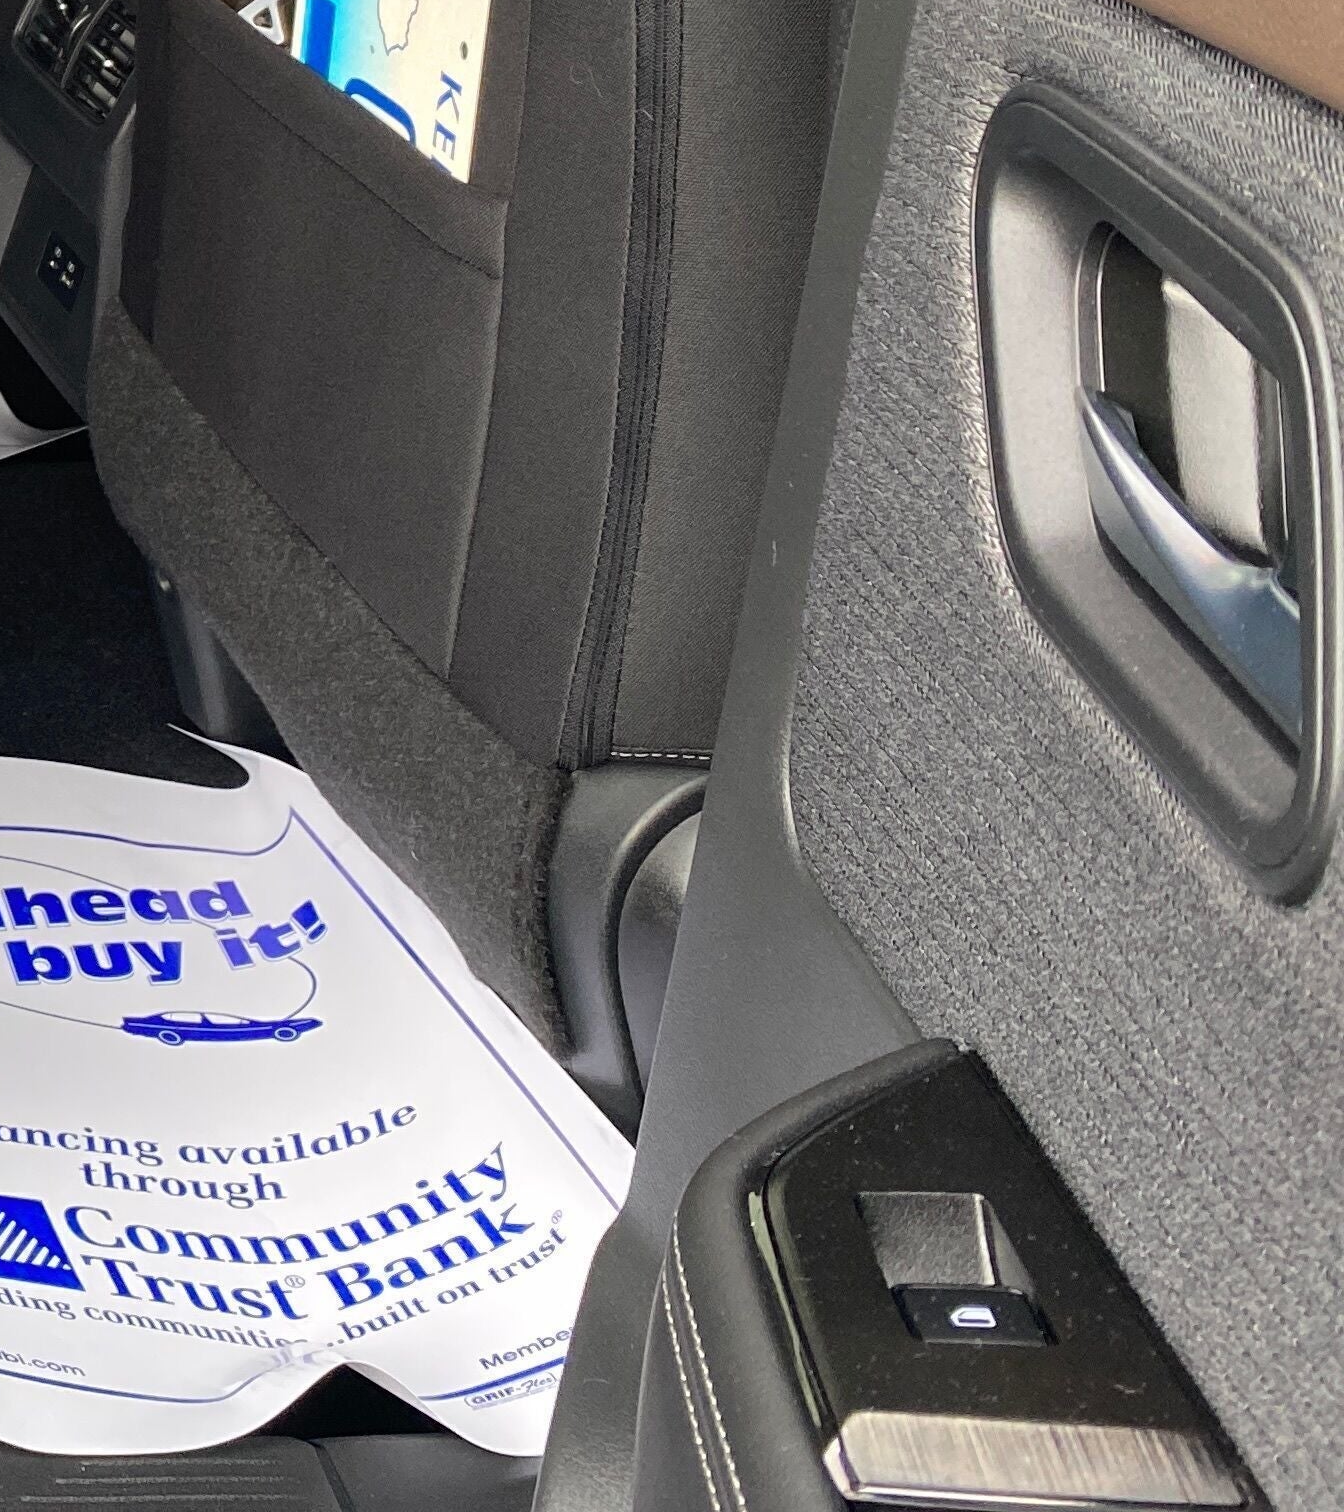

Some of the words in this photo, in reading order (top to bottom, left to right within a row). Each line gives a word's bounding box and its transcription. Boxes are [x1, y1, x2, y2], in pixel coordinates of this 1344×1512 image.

[4, 939, 184, 987] buy
[211, 897, 328, 970] it!
[177, 1101, 418, 1167] available
[63, 1140, 511, 1266] Community
[78, 1160, 288, 1210] through
[317, 1202, 536, 1311] Bank
[436, 1279, 485, 1305] on
